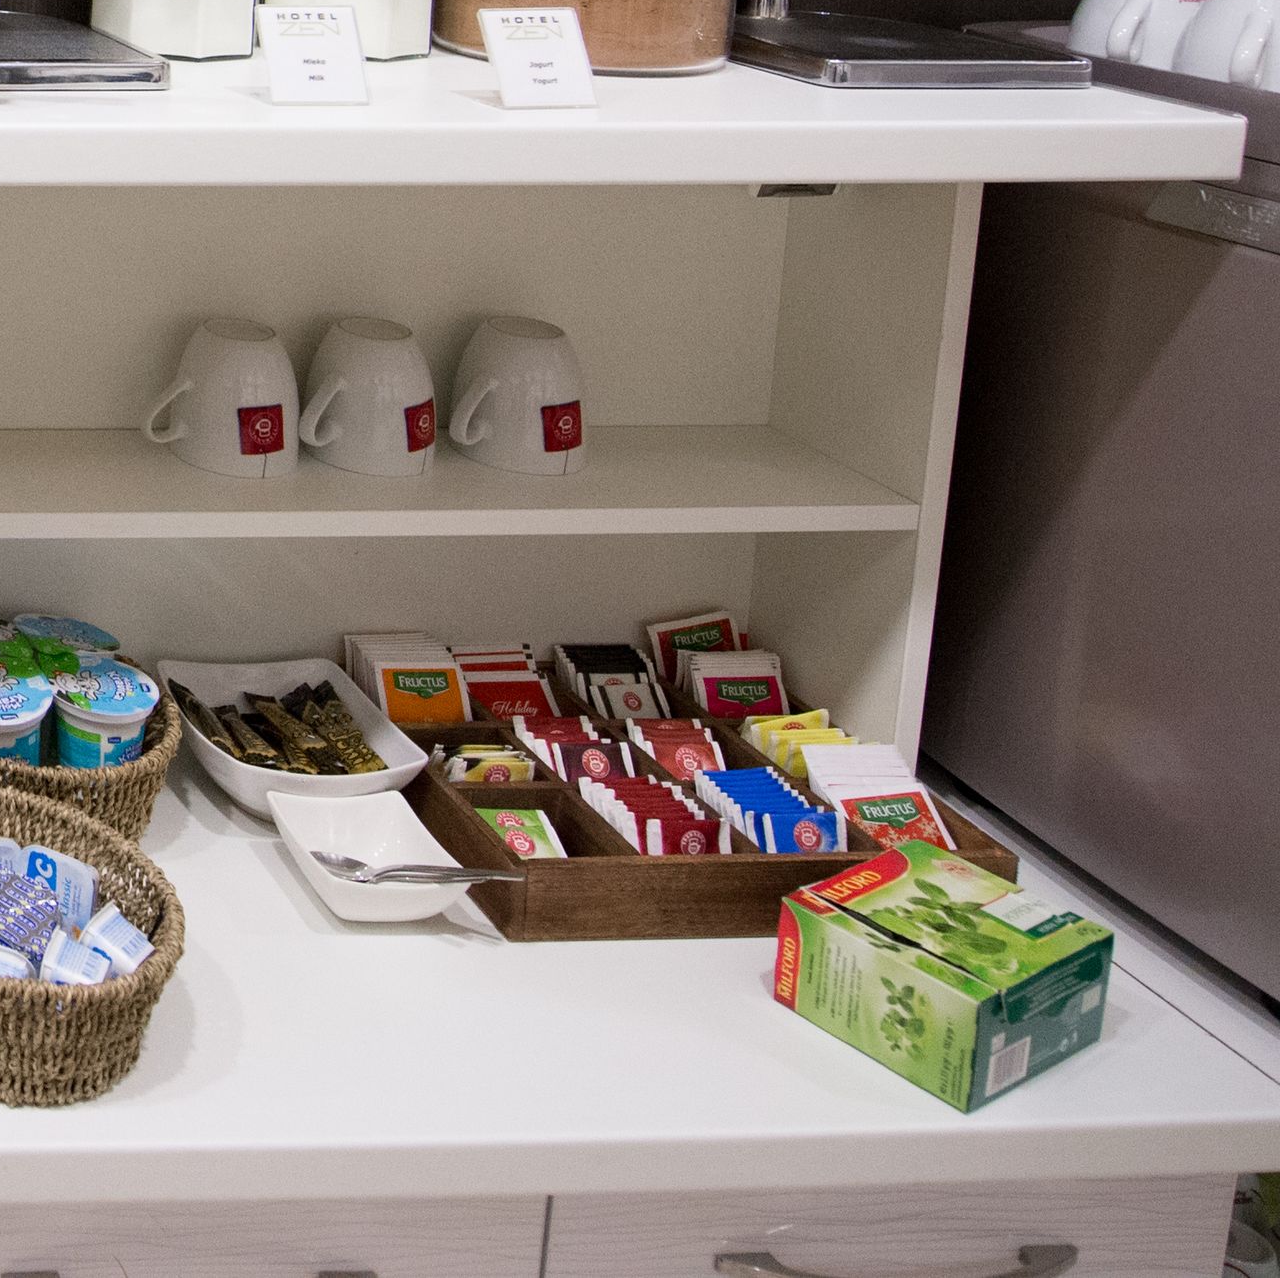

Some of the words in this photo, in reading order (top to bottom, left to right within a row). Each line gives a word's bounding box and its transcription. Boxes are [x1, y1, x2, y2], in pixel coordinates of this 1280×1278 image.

[501, 16, 559, 24] HOTEL
[278, 21, 340, 36] ZEN
[502, 25, 564, 40] ZEN
[675, 628, 720, 647] FRUCTUS
[398, 674, 447, 689] FRUCTUS
[722, 684, 768, 697] FRUCTUS
[492, 699, 539, 716] Holiday
[862, 802, 916, 819] FRUCTUS
[776, 937, 797, 1001] MILFORD
